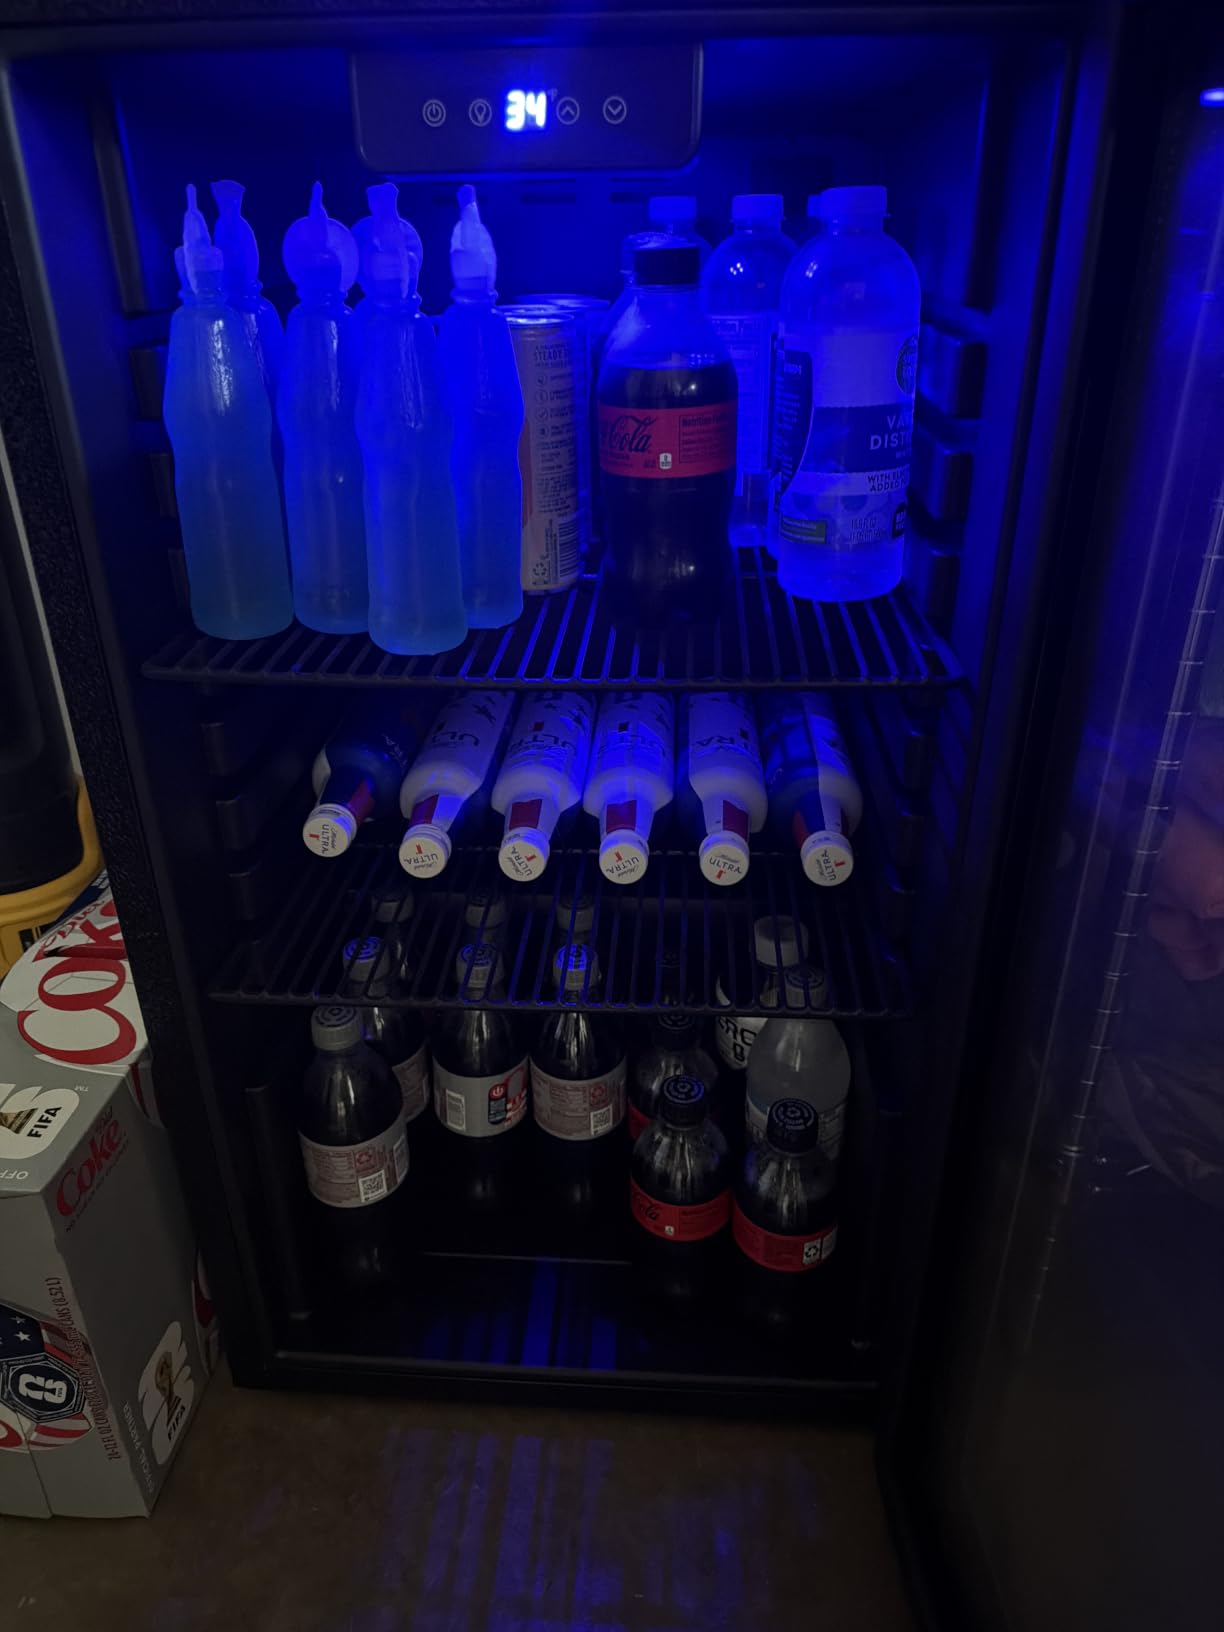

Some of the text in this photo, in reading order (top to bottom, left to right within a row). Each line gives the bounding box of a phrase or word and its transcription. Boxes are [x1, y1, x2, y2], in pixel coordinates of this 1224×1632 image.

[505, 89, 547, 131] 34
[609, 415, 657, 452] Cola
[320, 824, 329, 855] ULTRA
[402, 853, 438, 866] ULTRA
[511, 845, 533, 877] ULTRA
[606, 856, 639, 875] ULTRA
[709, 857, 743, 875] ULTRA
[820, 849, 837, 882] ULTRA
[26, 1106, 62, 1138] FIFA
[56, 1306, 72, 1327] CANS
